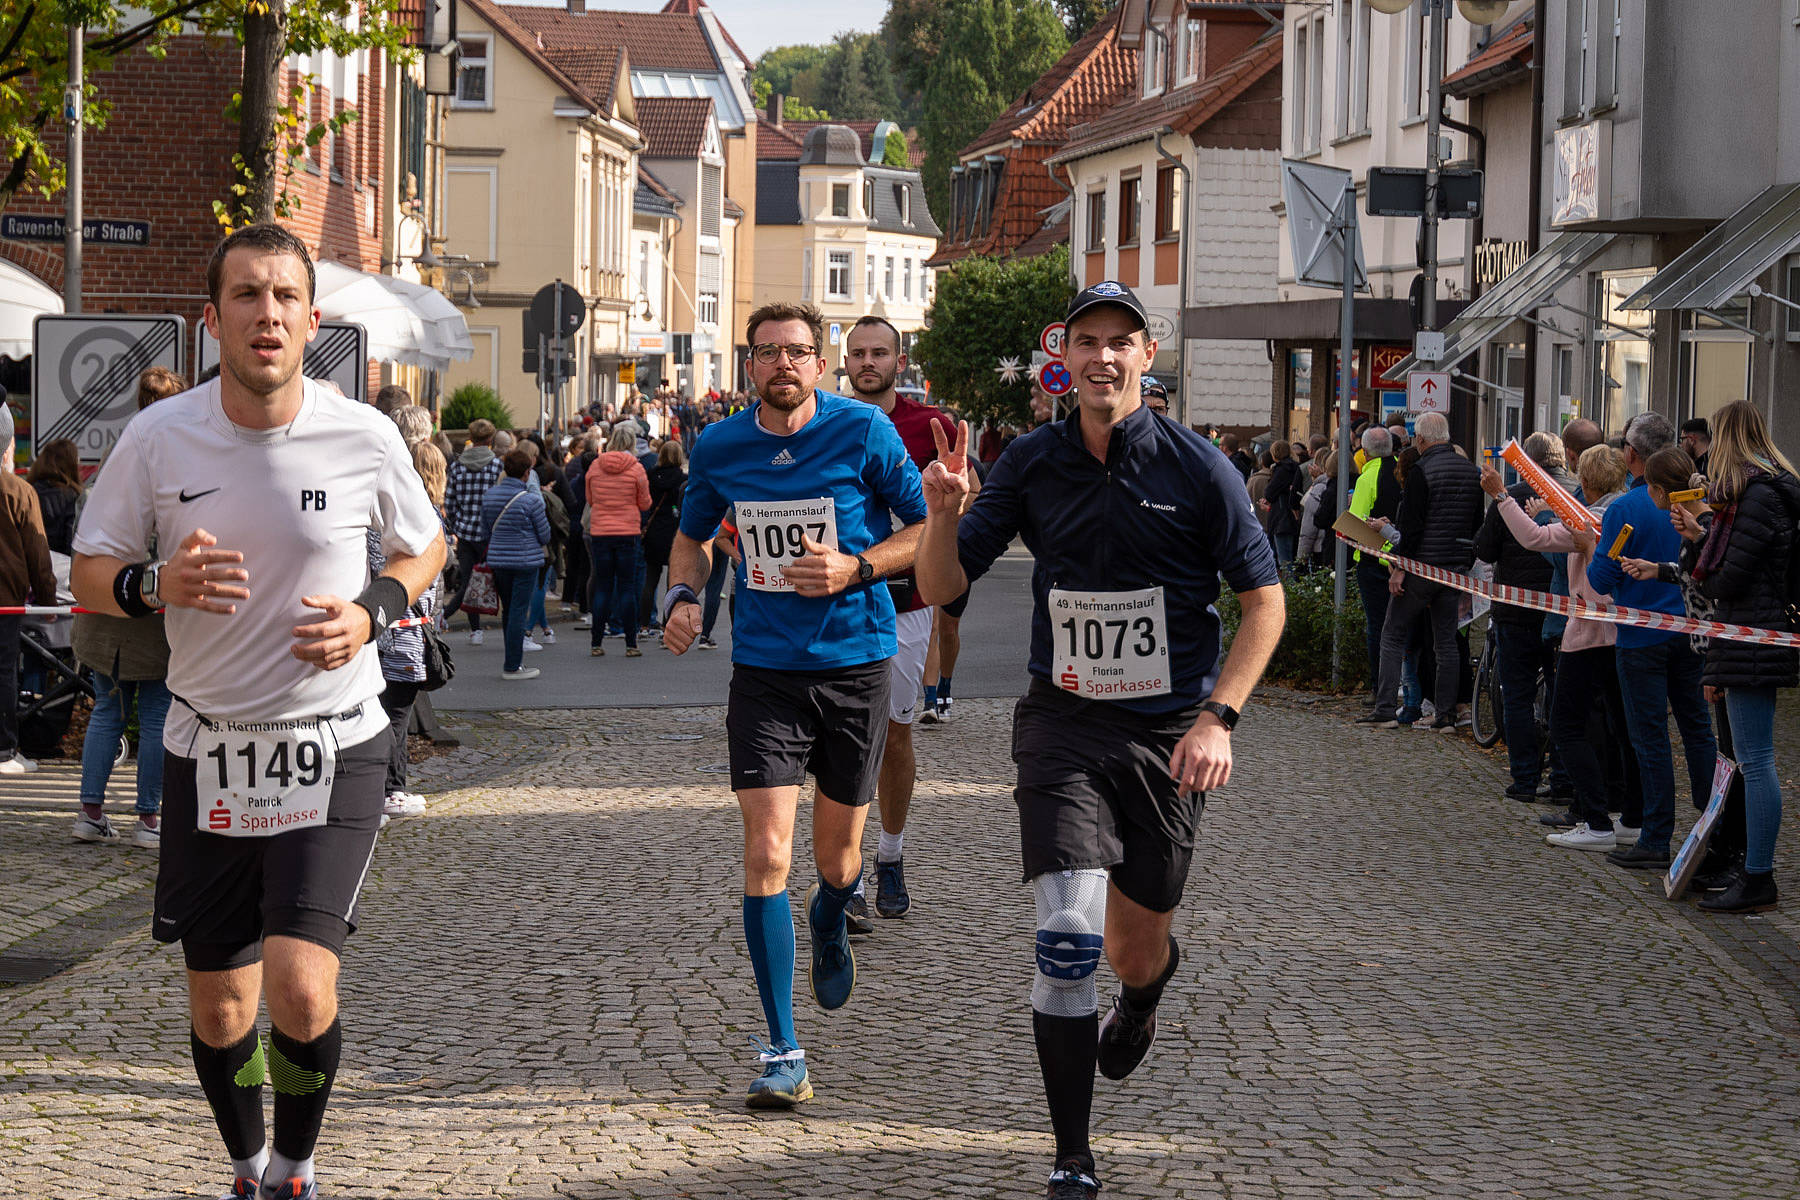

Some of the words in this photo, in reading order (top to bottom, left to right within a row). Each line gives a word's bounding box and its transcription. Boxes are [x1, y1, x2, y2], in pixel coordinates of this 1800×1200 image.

[8, 218, 97, 237] Ravensber
[102, 223, 142, 241] Straße
[1511, 458, 1550, 501] MARATHON
[301, 490, 327, 512] PB
[1151, 502, 1177, 512] VAUDE
[741, 508, 755, 518] 49.
[757, 506, 827, 518] Hermannslauf
[746, 522, 826, 558] 1097
[1056, 598, 1072, 609] 49.
[1074, 596, 1155, 611] Hermannslauf
[1061, 616, 1156, 660] 1073
[1160, 646, 1167, 656] B
[1092, 666, 1124, 676] Florian
[1086, 677, 1162, 696] Sparkasse
[227, 719, 320, 733] Hermannslauf
[207, 740, 323, 789] 1149
[248, 796, 282, 808] Patrick
[240, 808, 318, 832] Sparkasse
